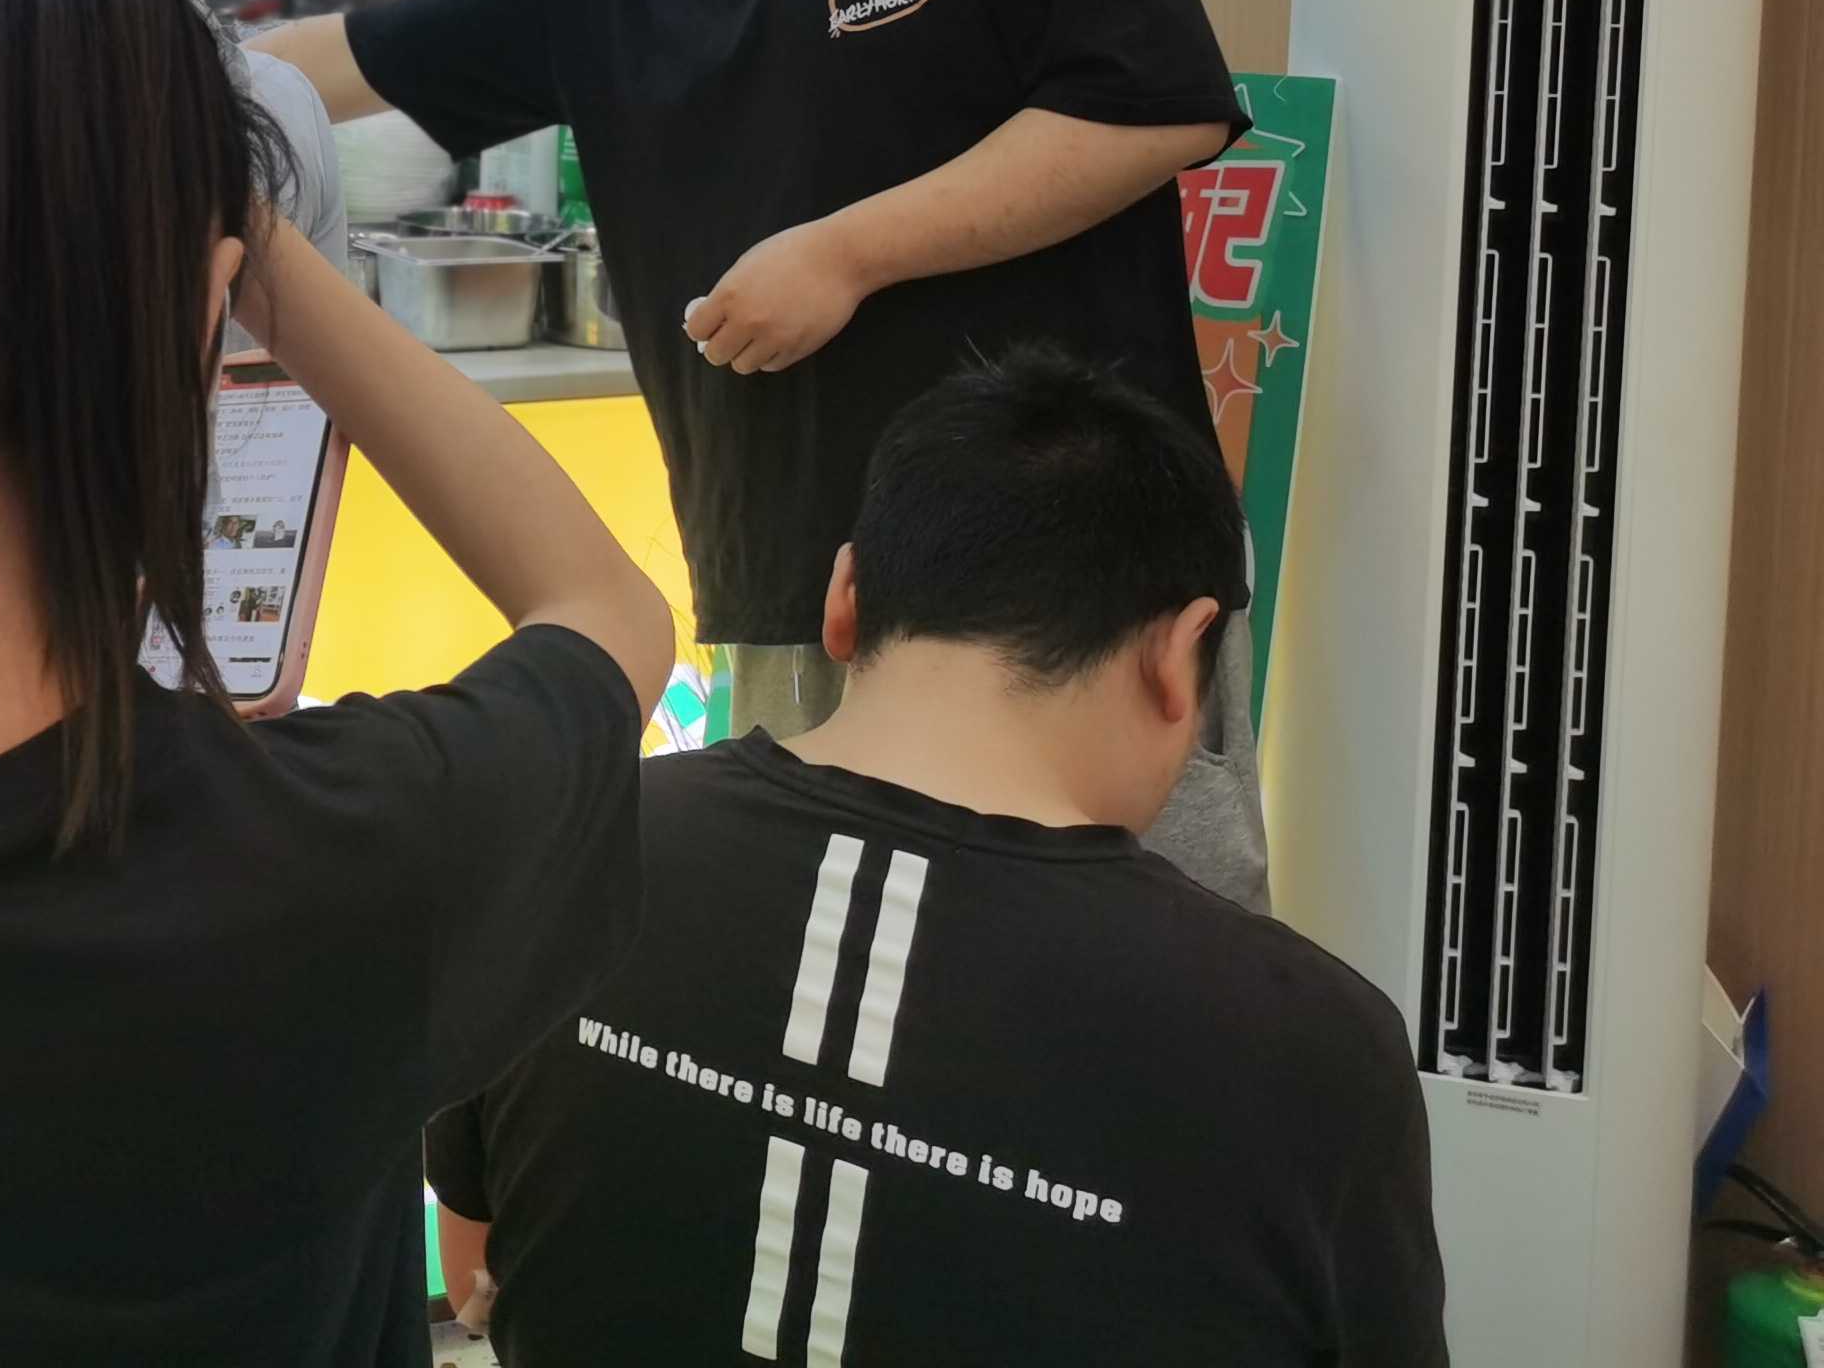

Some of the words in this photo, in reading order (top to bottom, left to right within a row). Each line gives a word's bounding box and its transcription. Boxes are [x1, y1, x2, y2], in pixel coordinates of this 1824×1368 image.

[578, 1016, 658, 1069] While
[665, 1050, 753, 1103] there
[762, 1082, 795, 1118] is
[803, 1096, 862, 1140] life
[871, 1121, 968, 1177] there
[977, 1154, 1014, 1191] is
[1024, 1168, 1122, 1224] hope
